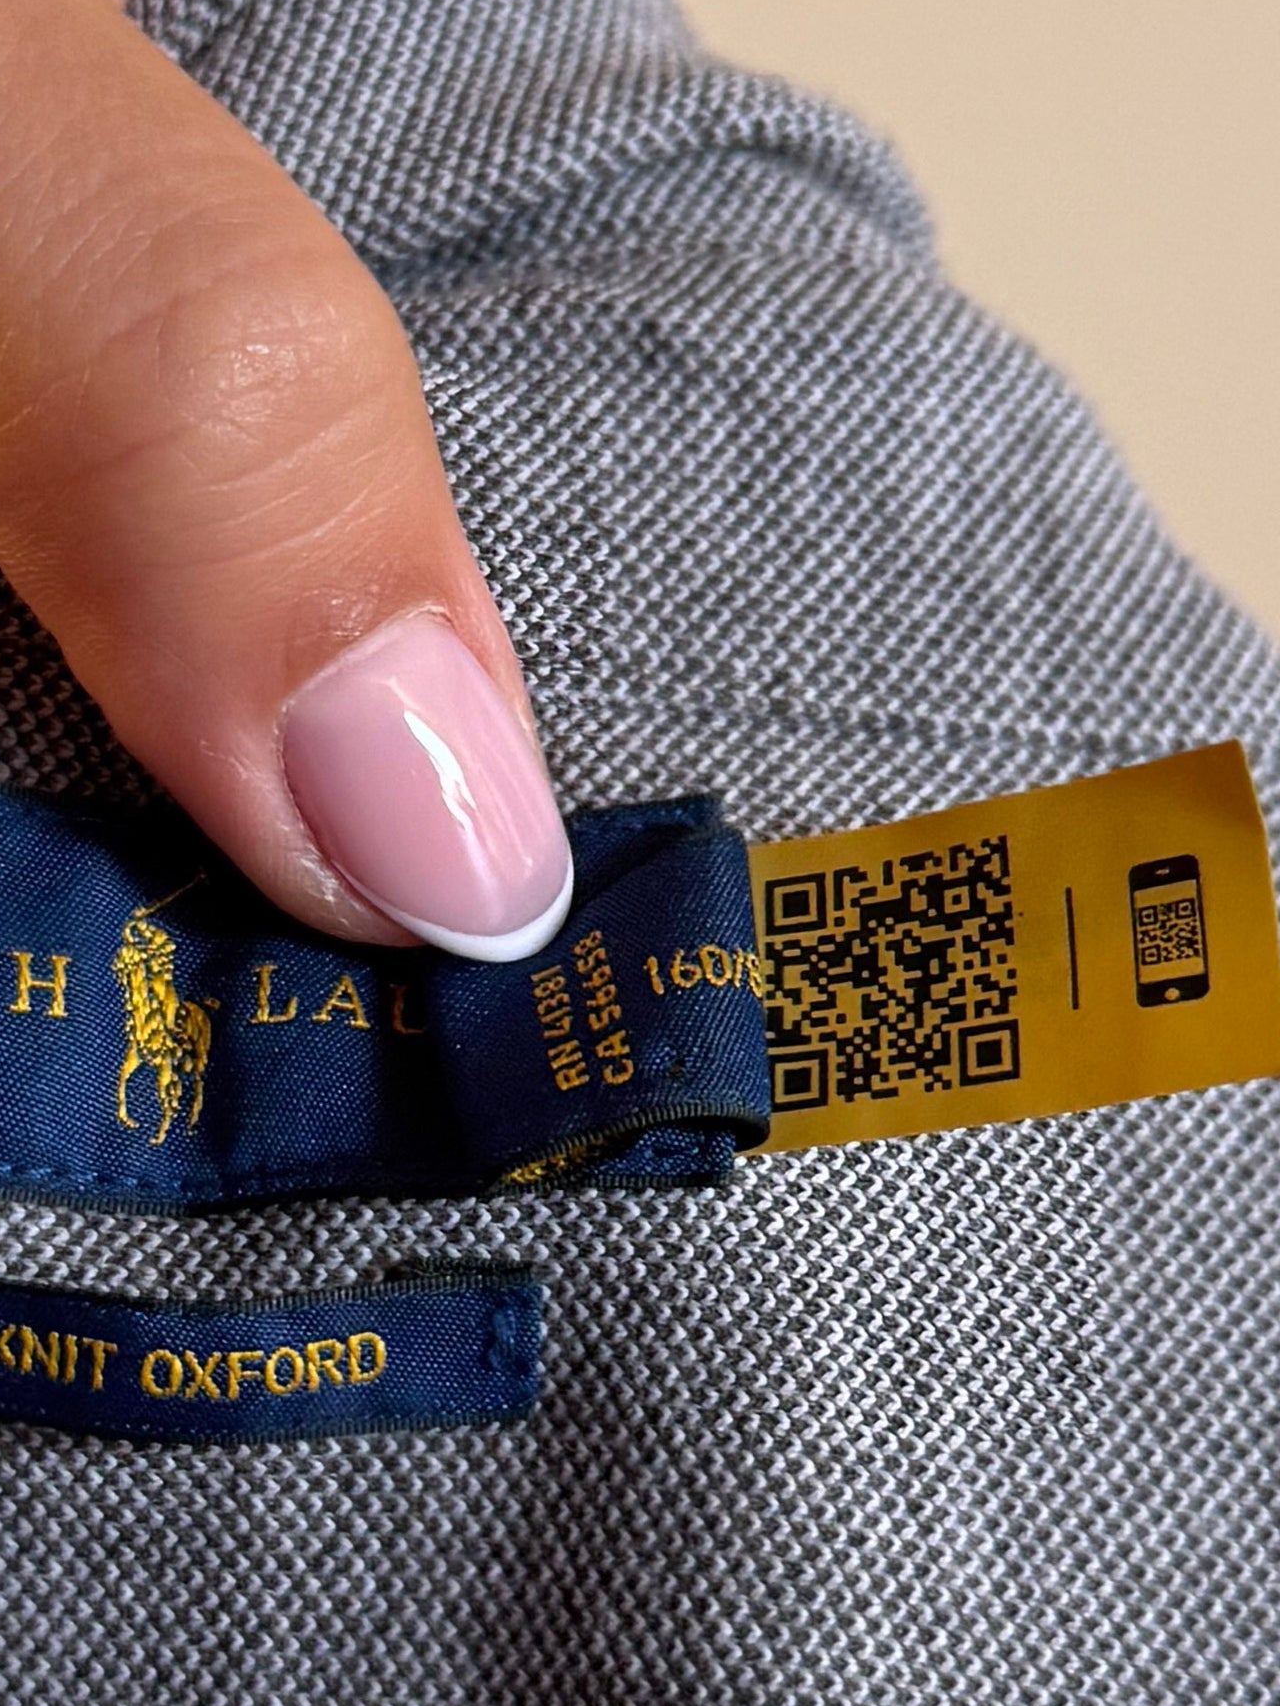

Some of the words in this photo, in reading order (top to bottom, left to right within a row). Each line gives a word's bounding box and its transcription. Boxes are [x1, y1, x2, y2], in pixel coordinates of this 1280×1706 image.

[531, 964, 572, 1039] 41381
[573, 929, 621, 1031] 56658
[548, 1039, 589, 1092] RN
[594, 1029, 634, 1086] CA
[139, 1332, 387, 1400] OXFORD
